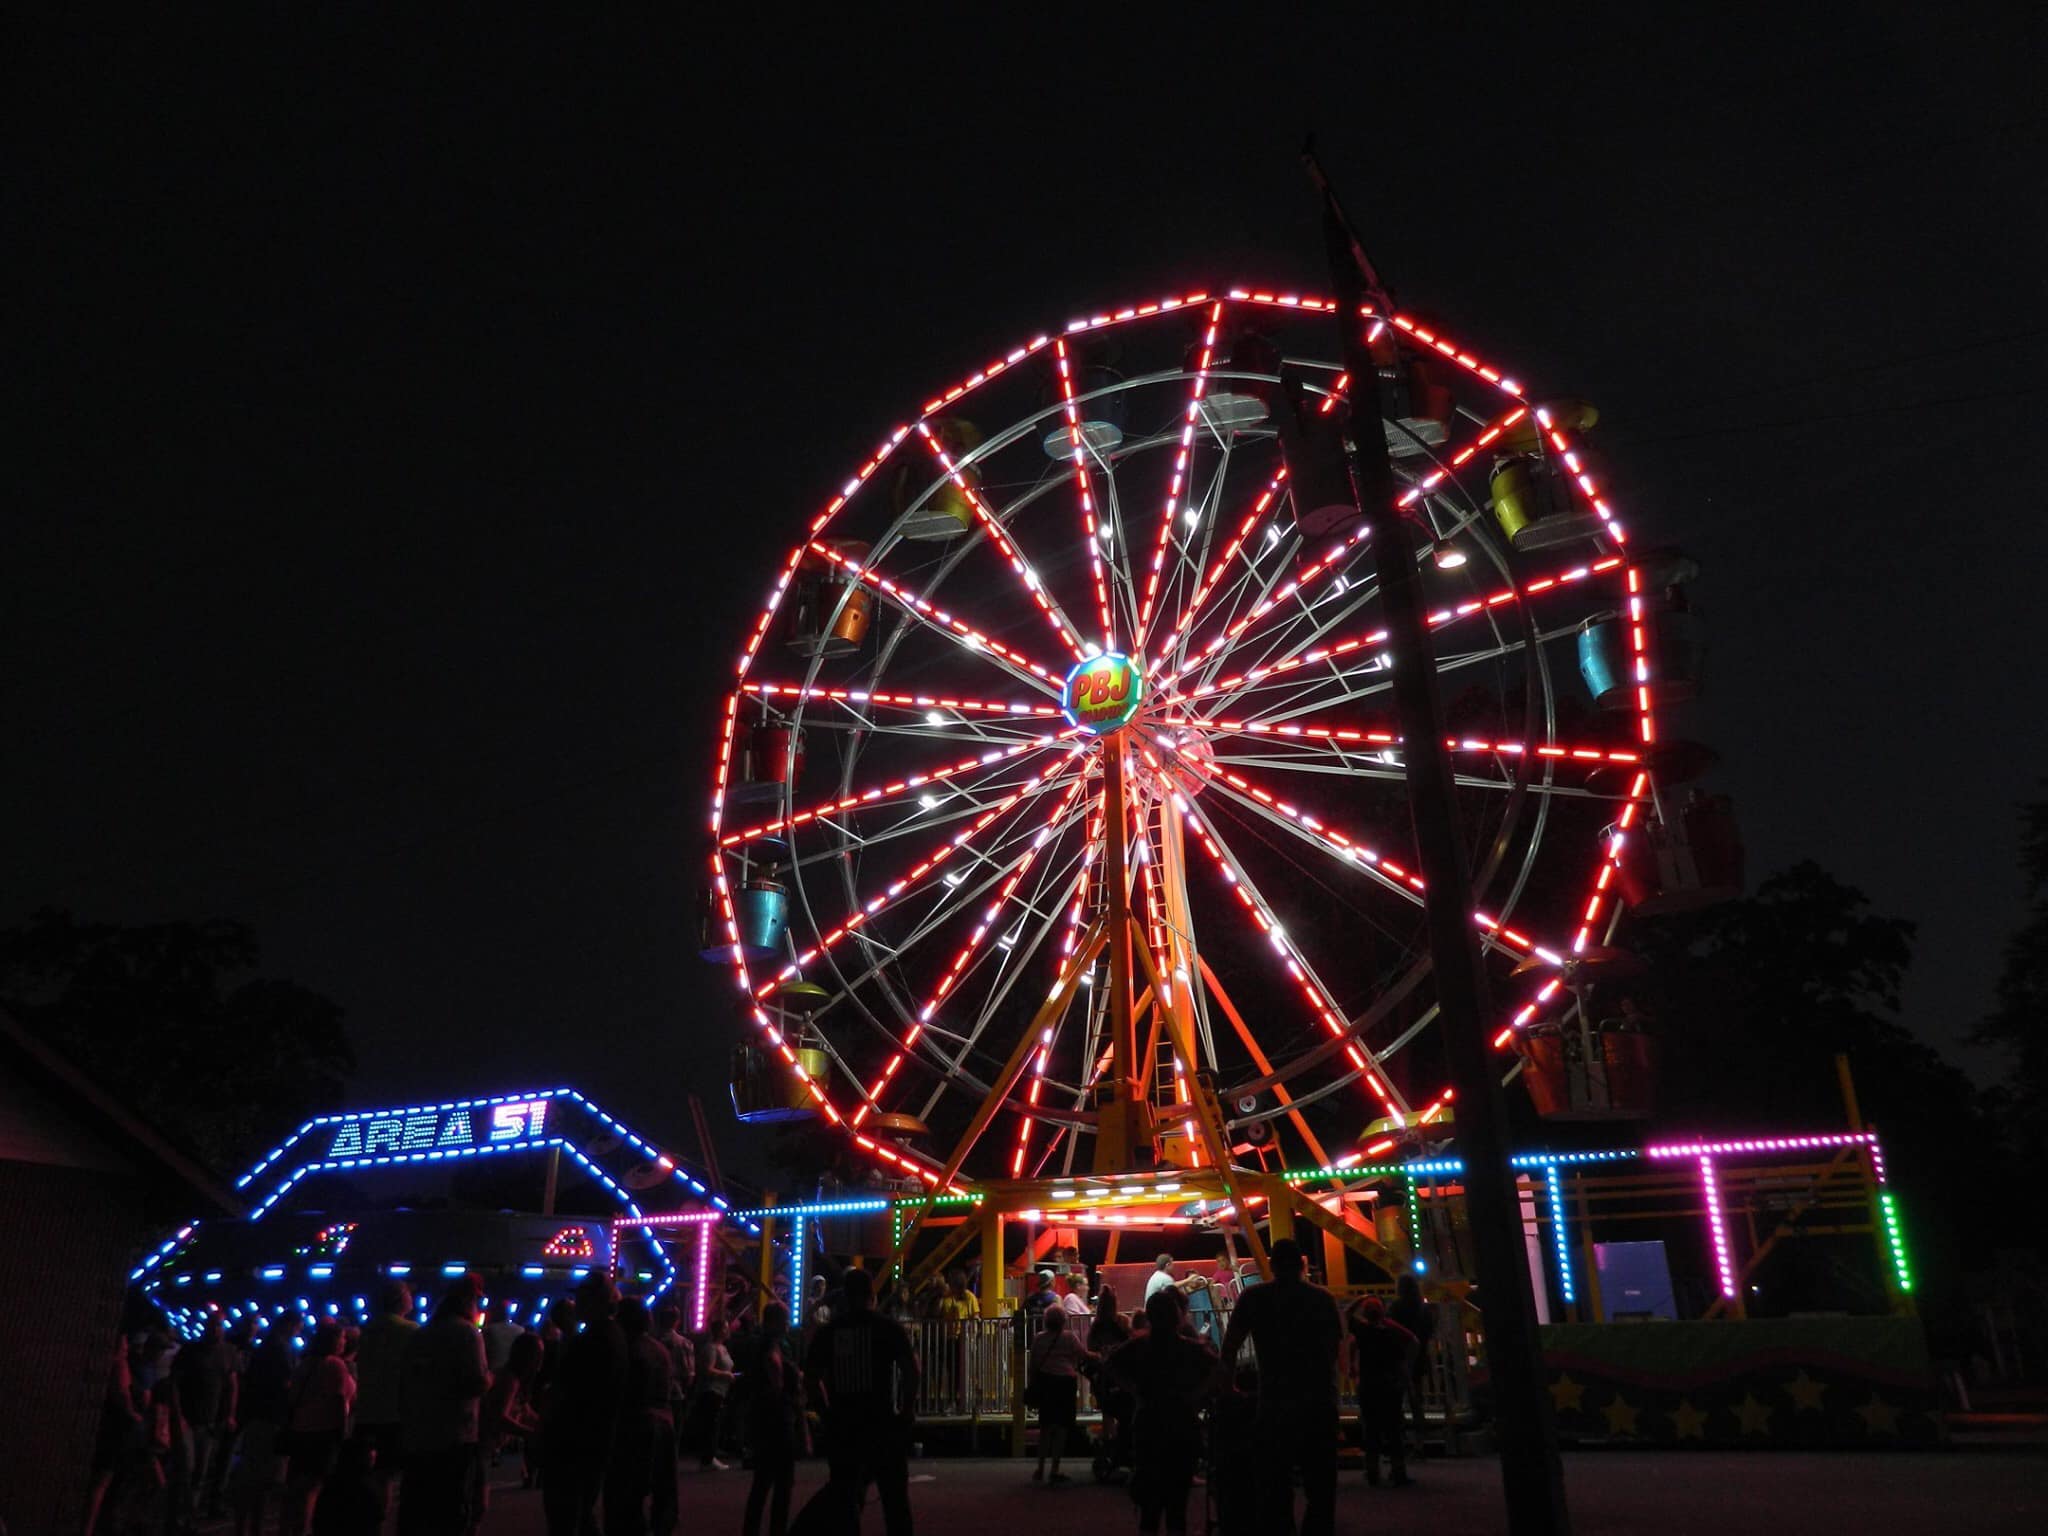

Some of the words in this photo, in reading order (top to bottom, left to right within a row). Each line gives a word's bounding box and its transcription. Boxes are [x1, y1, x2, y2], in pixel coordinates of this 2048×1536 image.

[1073, 667, 1130, 708] PBJ
[328, 1111, 473, 1157] AREA
[490, 1100, 547, 1141] 51
